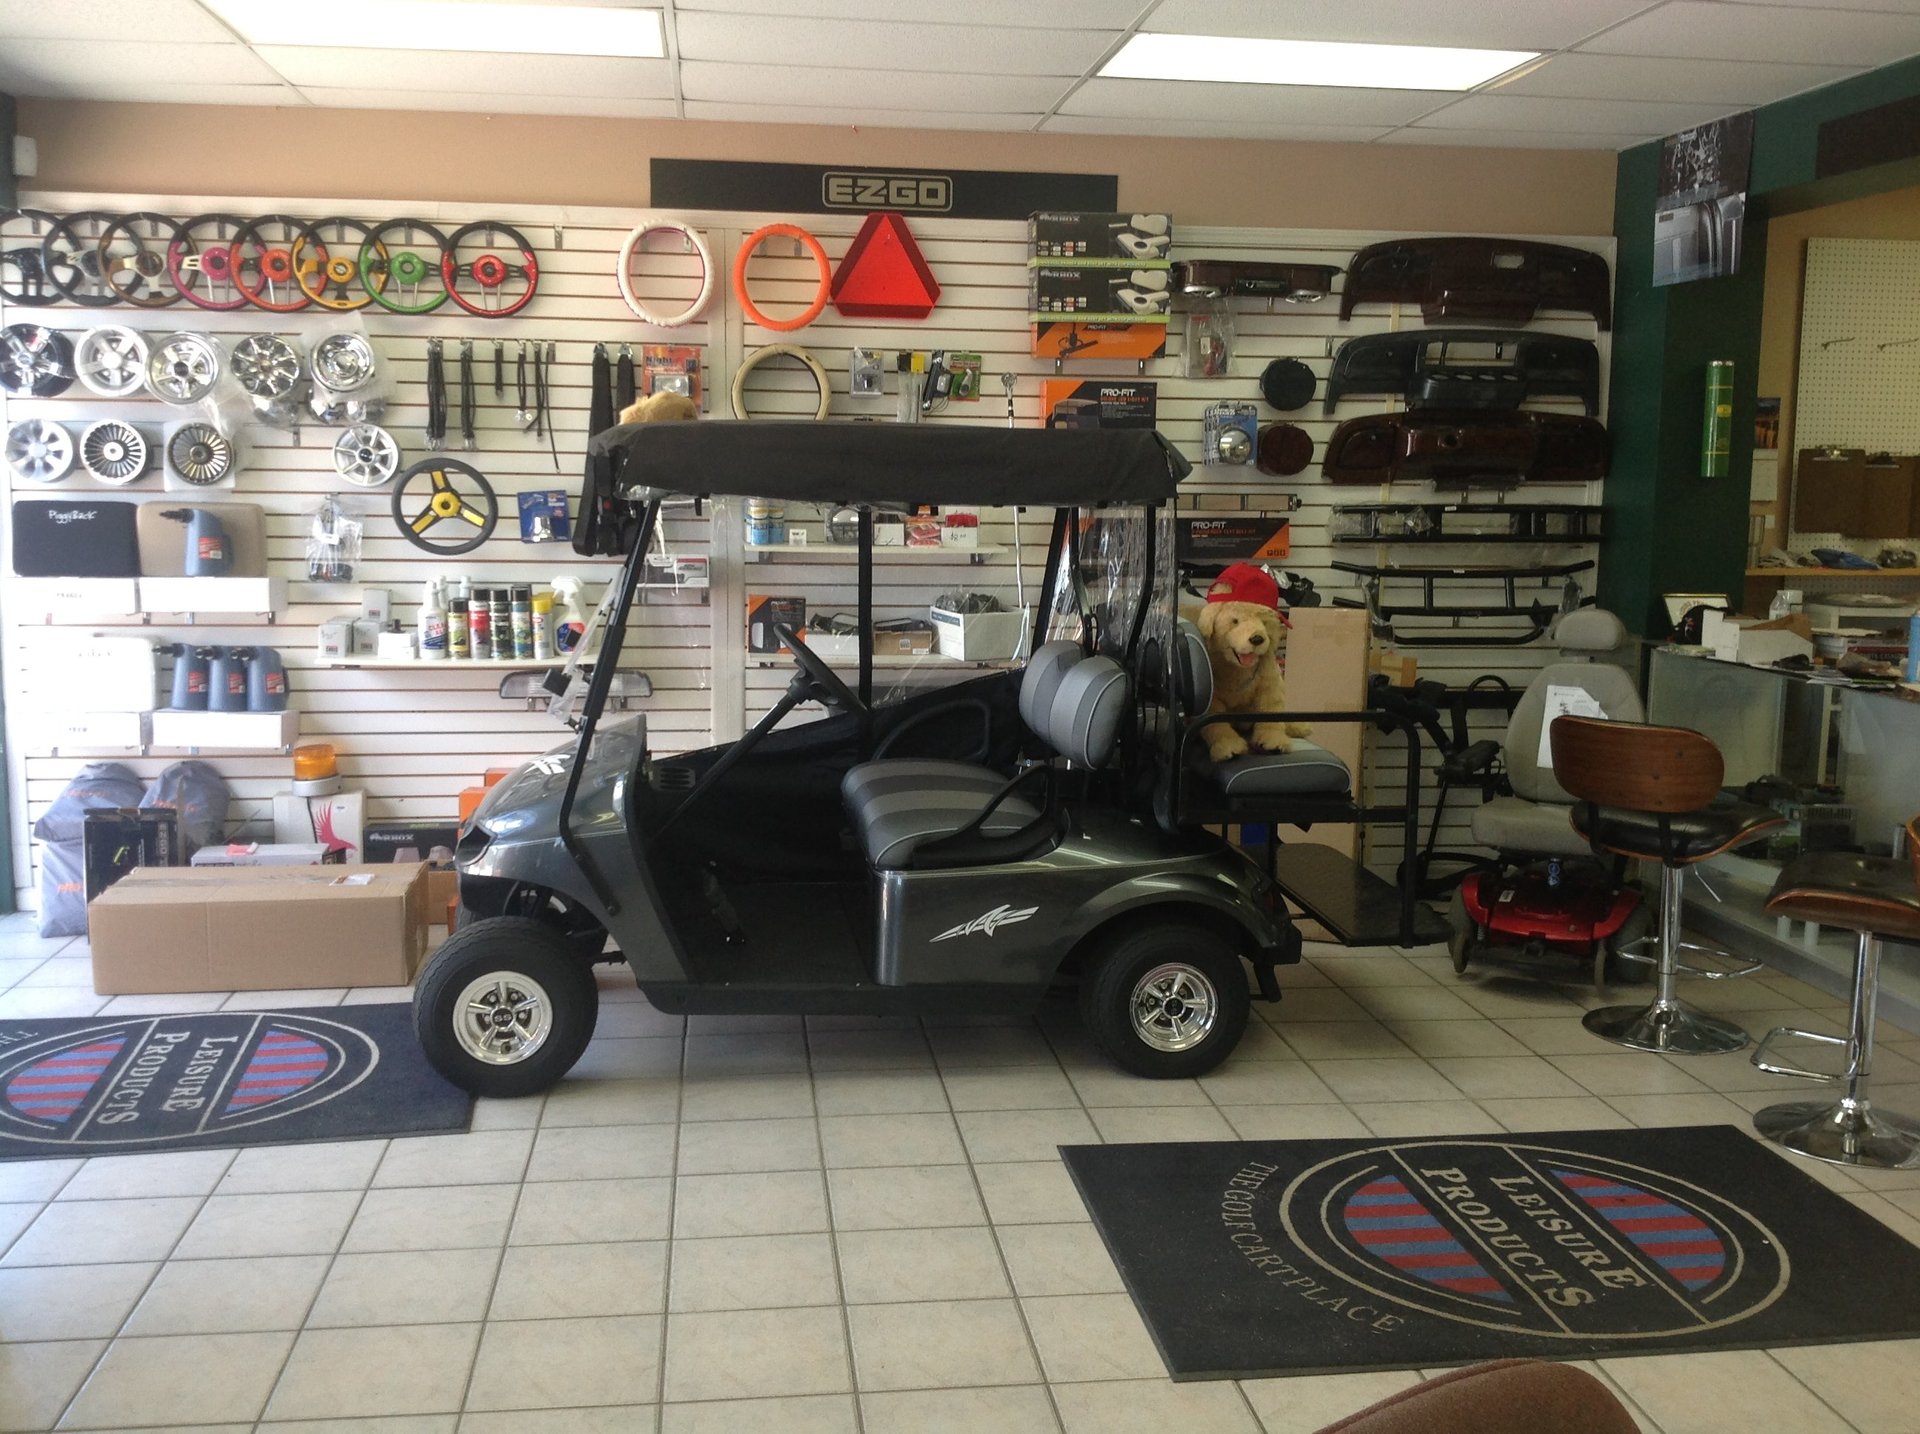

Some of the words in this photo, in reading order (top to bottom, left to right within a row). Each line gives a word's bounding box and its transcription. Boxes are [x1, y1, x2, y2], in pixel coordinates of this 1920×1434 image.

[828, 177, 946, 206] EZGO
[1100, 388, 1136, 397] PRO-FIT
[1191, 521, 1227, 530] PRO-FIT
[96, 1031, 191, 1125] PRODUCTS
[159, 1035, 239, 1112] LEISURE
[1229, 1161, 1279, 1190] THE
[1221, 1189, 1256, 1231] GOLF
[1489, 1175, 1648, 1289] LEISURE
[1230, 1233, 1299, 1277] CART
[1419, 1167, 1597, 1307] PRODUCTS
[1283, 1276, 1404, 1332] PLACE
